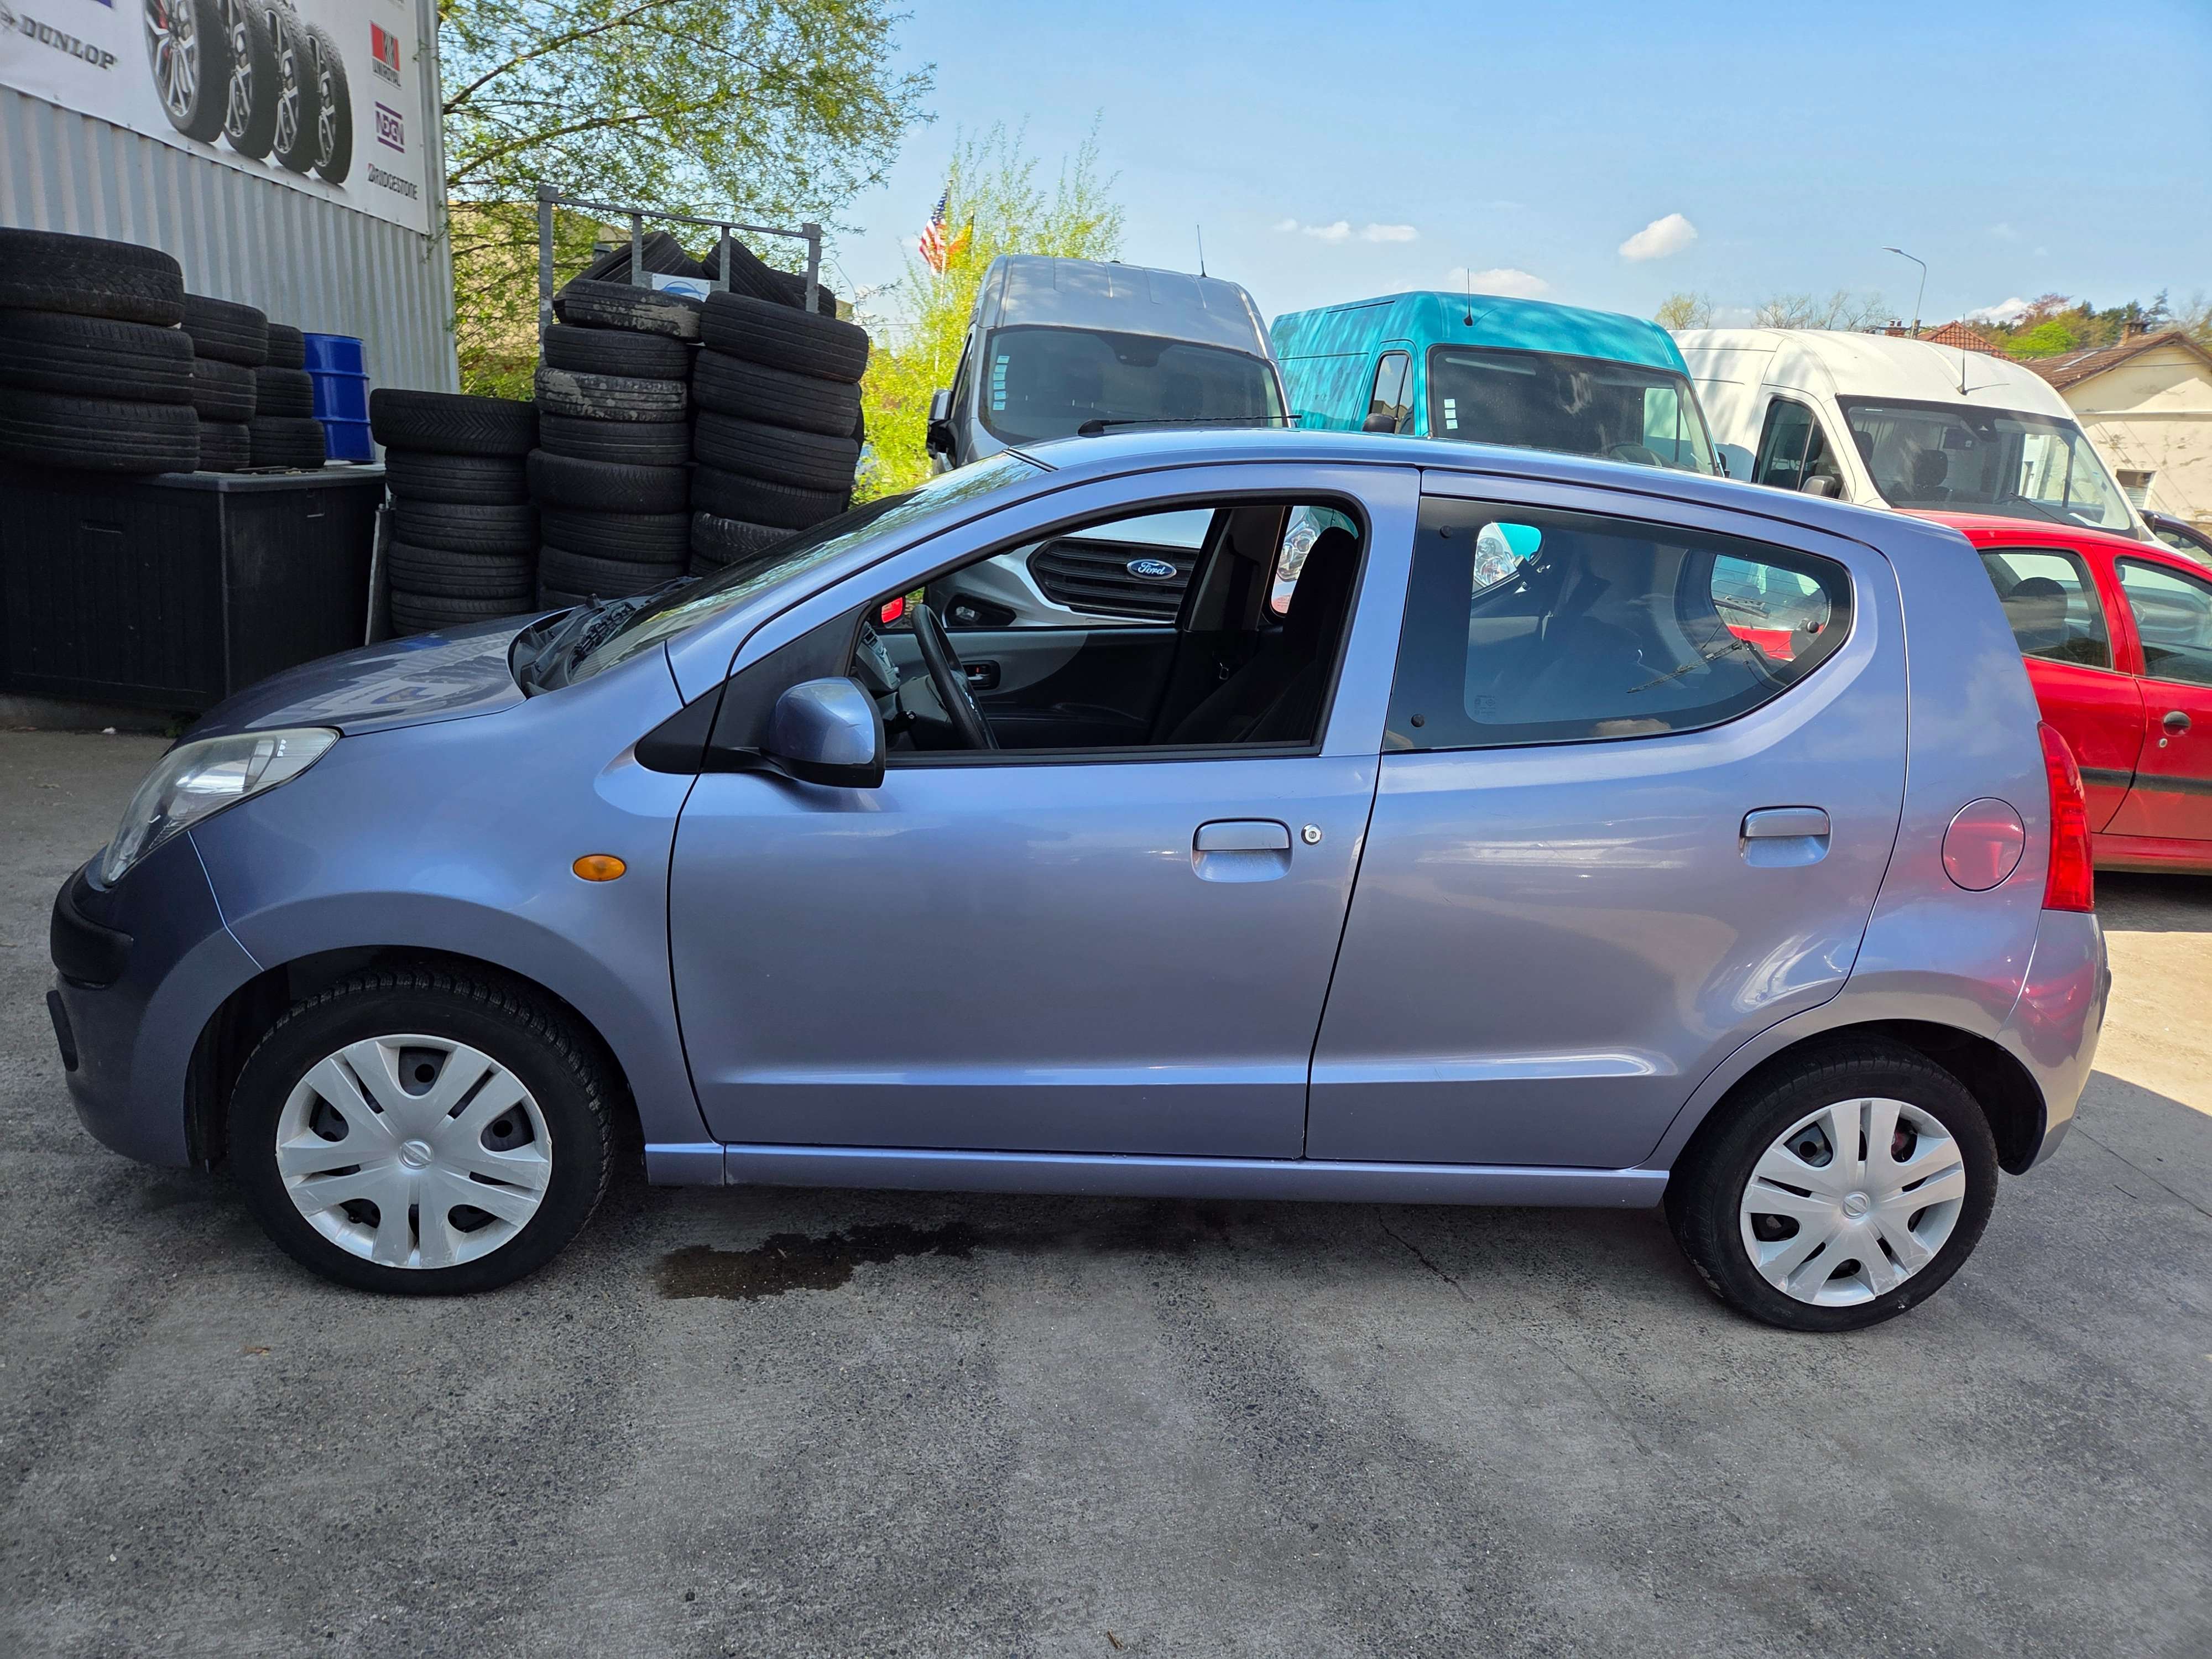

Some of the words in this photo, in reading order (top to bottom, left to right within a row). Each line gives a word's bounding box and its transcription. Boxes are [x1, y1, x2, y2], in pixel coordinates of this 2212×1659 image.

[18, 13, 115, 70] DUNLOP
[367, 163, 418, 200] BRIDGESTONE
[1138, 561, 1166, 575] Ford
